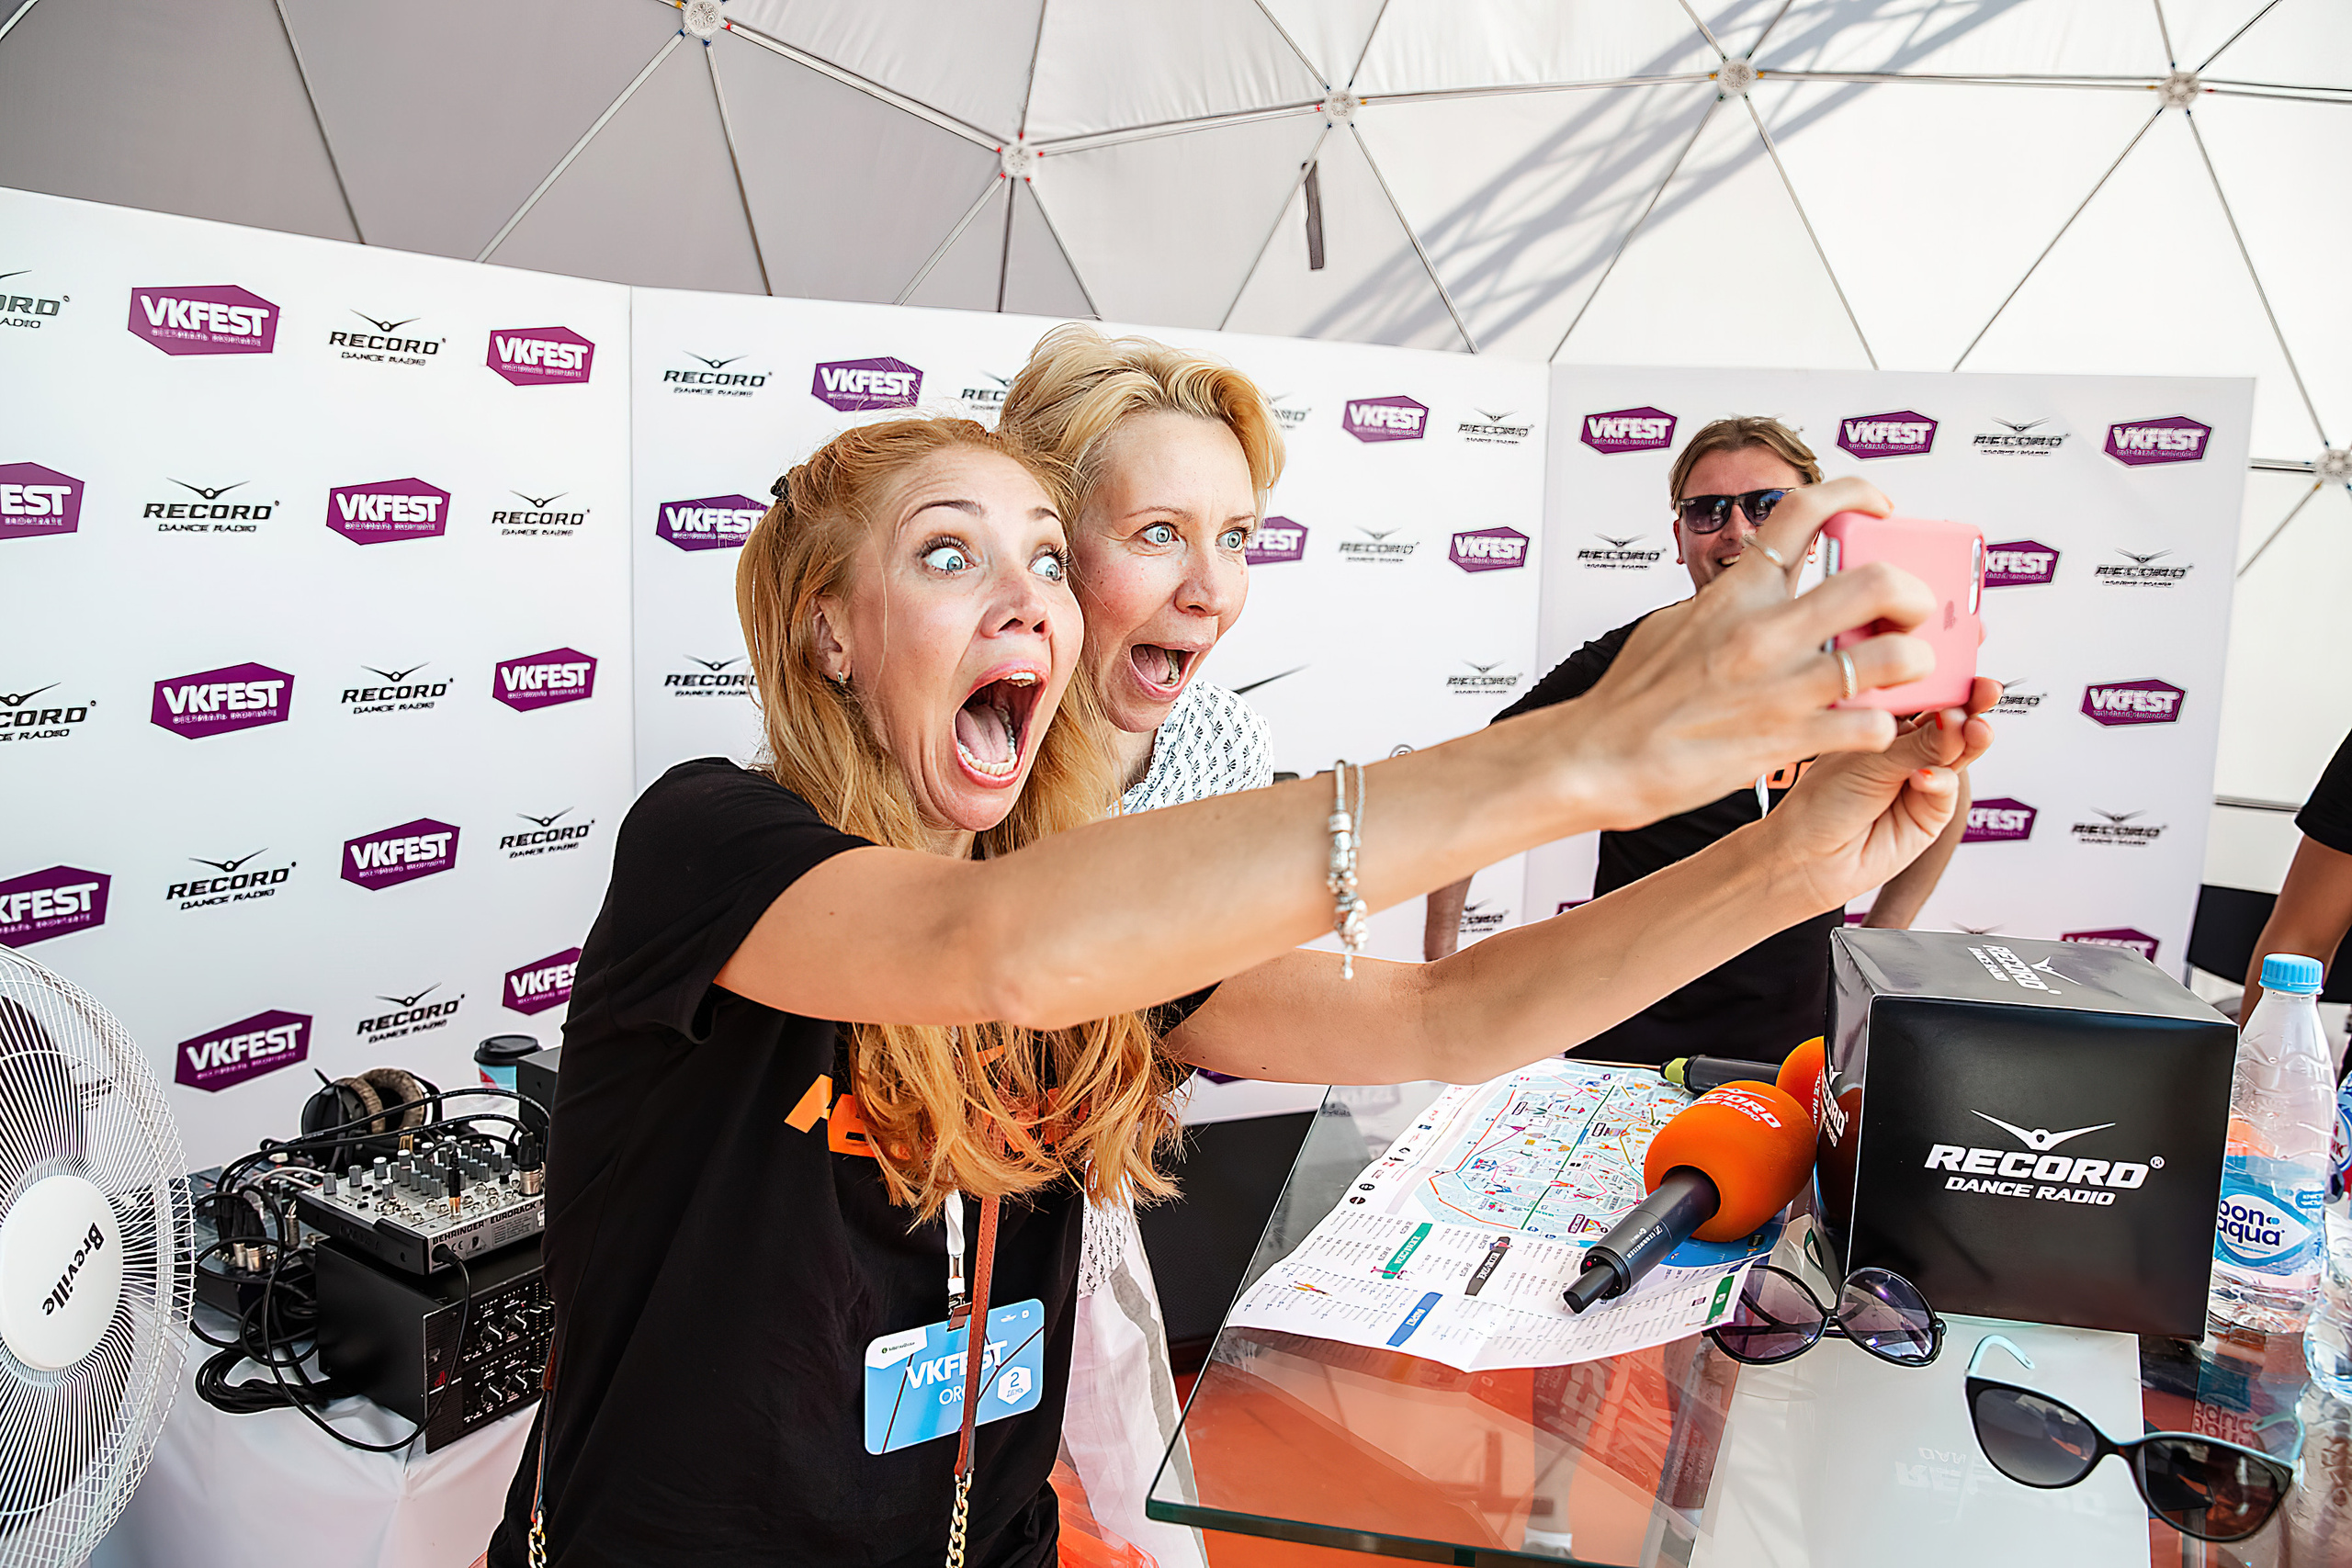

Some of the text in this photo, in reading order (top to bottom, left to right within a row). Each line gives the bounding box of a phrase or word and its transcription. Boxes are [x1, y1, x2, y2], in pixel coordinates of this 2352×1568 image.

[140, 295, 269, 336] VKFEST
[328, 331, 440, 355] RECORD
[495, 335, 588, 370] VKFEST
[663, 370, 766, 388] RECORD
[820, 367, 917, 397] VKFEST
[961, 389, 1007, 402] REC
[1349, 404, 1425, 429] VKFEST
[1588, 416, 1672, 439] VKFEST
[143, 502, 272, 520] RECORD
[335, 493, 443, 523] VKFEST
[492, 511, 585, 525] RECORD
[1261, 528, 1303, 550] FEST
[1986, 551, 2055, 574] KFEST
[501, 662, 591, 691] VKFEST
[162, 680, 285, 715] VKFEST
[342, 682, 447, 704] RECORD
[0, 706, 88, 728] CORD
[351, 832, 452, 869] VKFEST
[500, 825, 590, 850] RECORD
[165, 867, 289, 900] RECORD
[0, 882, 99, 923] KFEST
[510, 962, 578, 998] VKFE
[356, 1000, 459, 1036] RECORD
[187, 1022, 302, 1071] VKFEST
[1697, 1093, 1781, 1128] CORD
[1925, 1144, 2151, 1190] RECORD
[1945, 1176, 2117, 1206] DANCE RADIO
[2217, 1216, 2280, 1246] aqua
[42, 1223, 105, 1315] Breville
[1010, 1371, 1020, 1388] 2
[938, 1385, 966, 1405] OR
